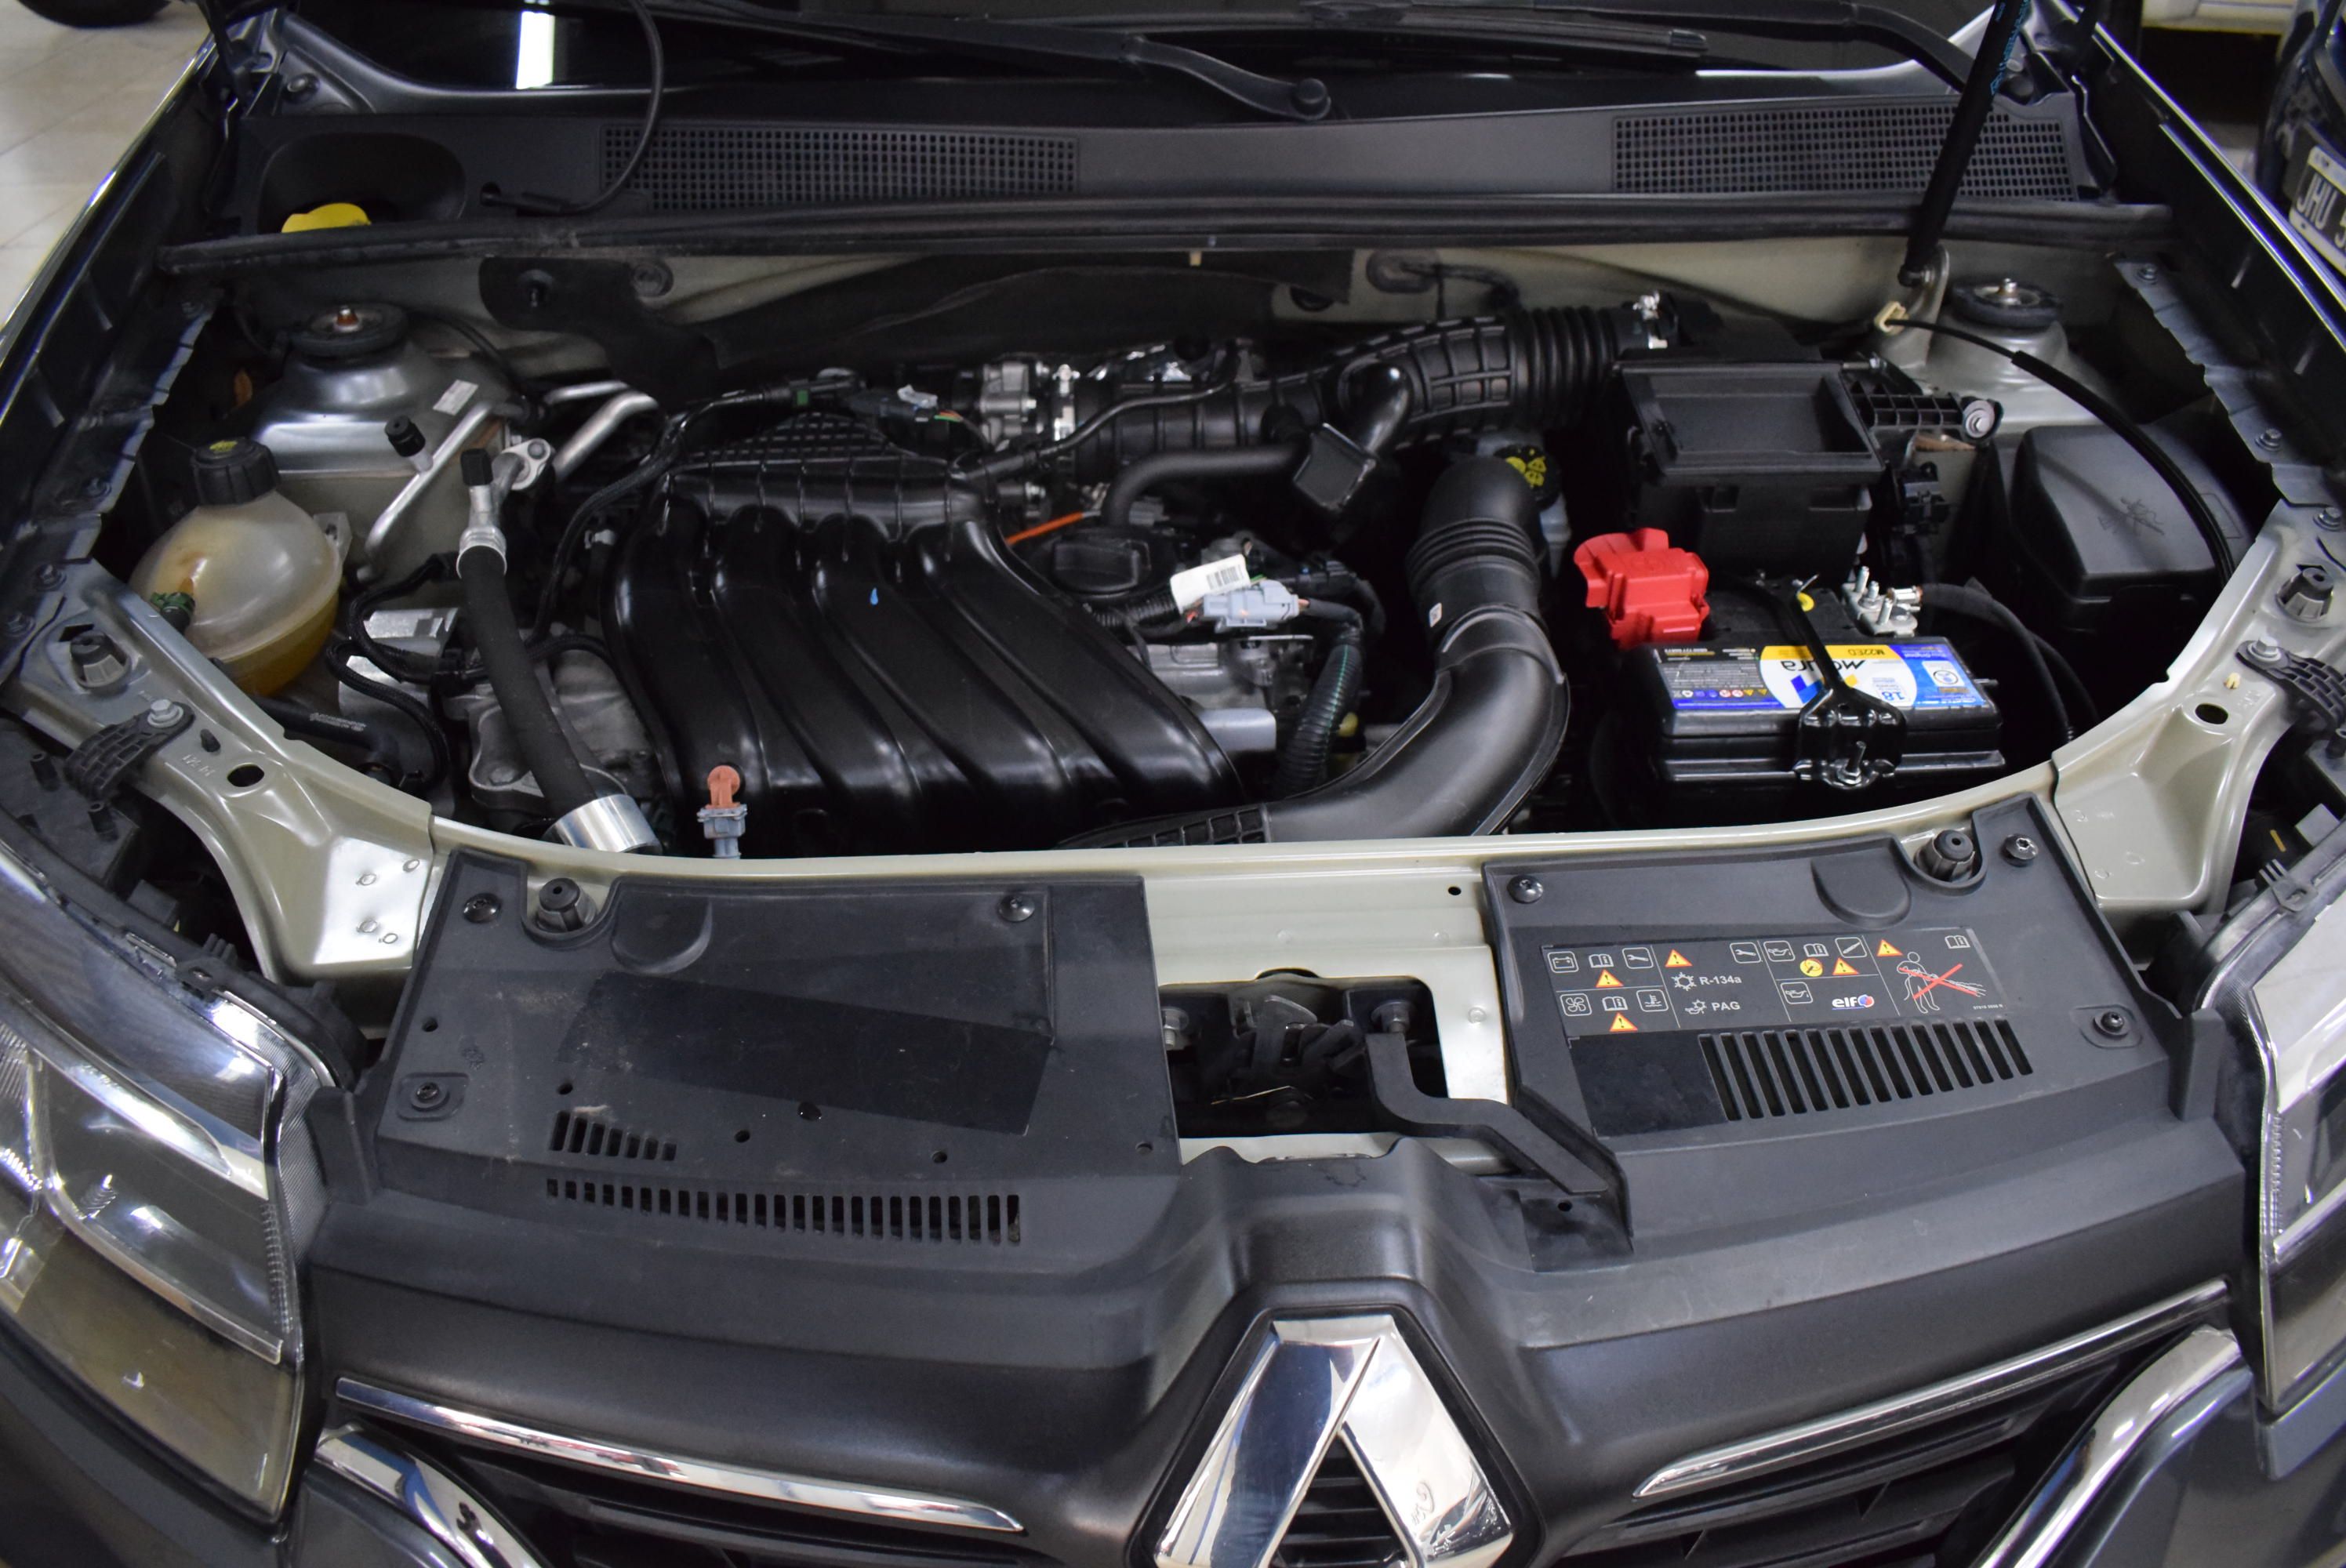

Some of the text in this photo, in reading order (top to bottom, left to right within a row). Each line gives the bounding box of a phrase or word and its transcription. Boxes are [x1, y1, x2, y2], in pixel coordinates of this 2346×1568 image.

[2297, 172, 2337, 230] JHU
[1699, 975, 1742, 985] R-134a
[1711, 1000, 1741, 1011] PAG
